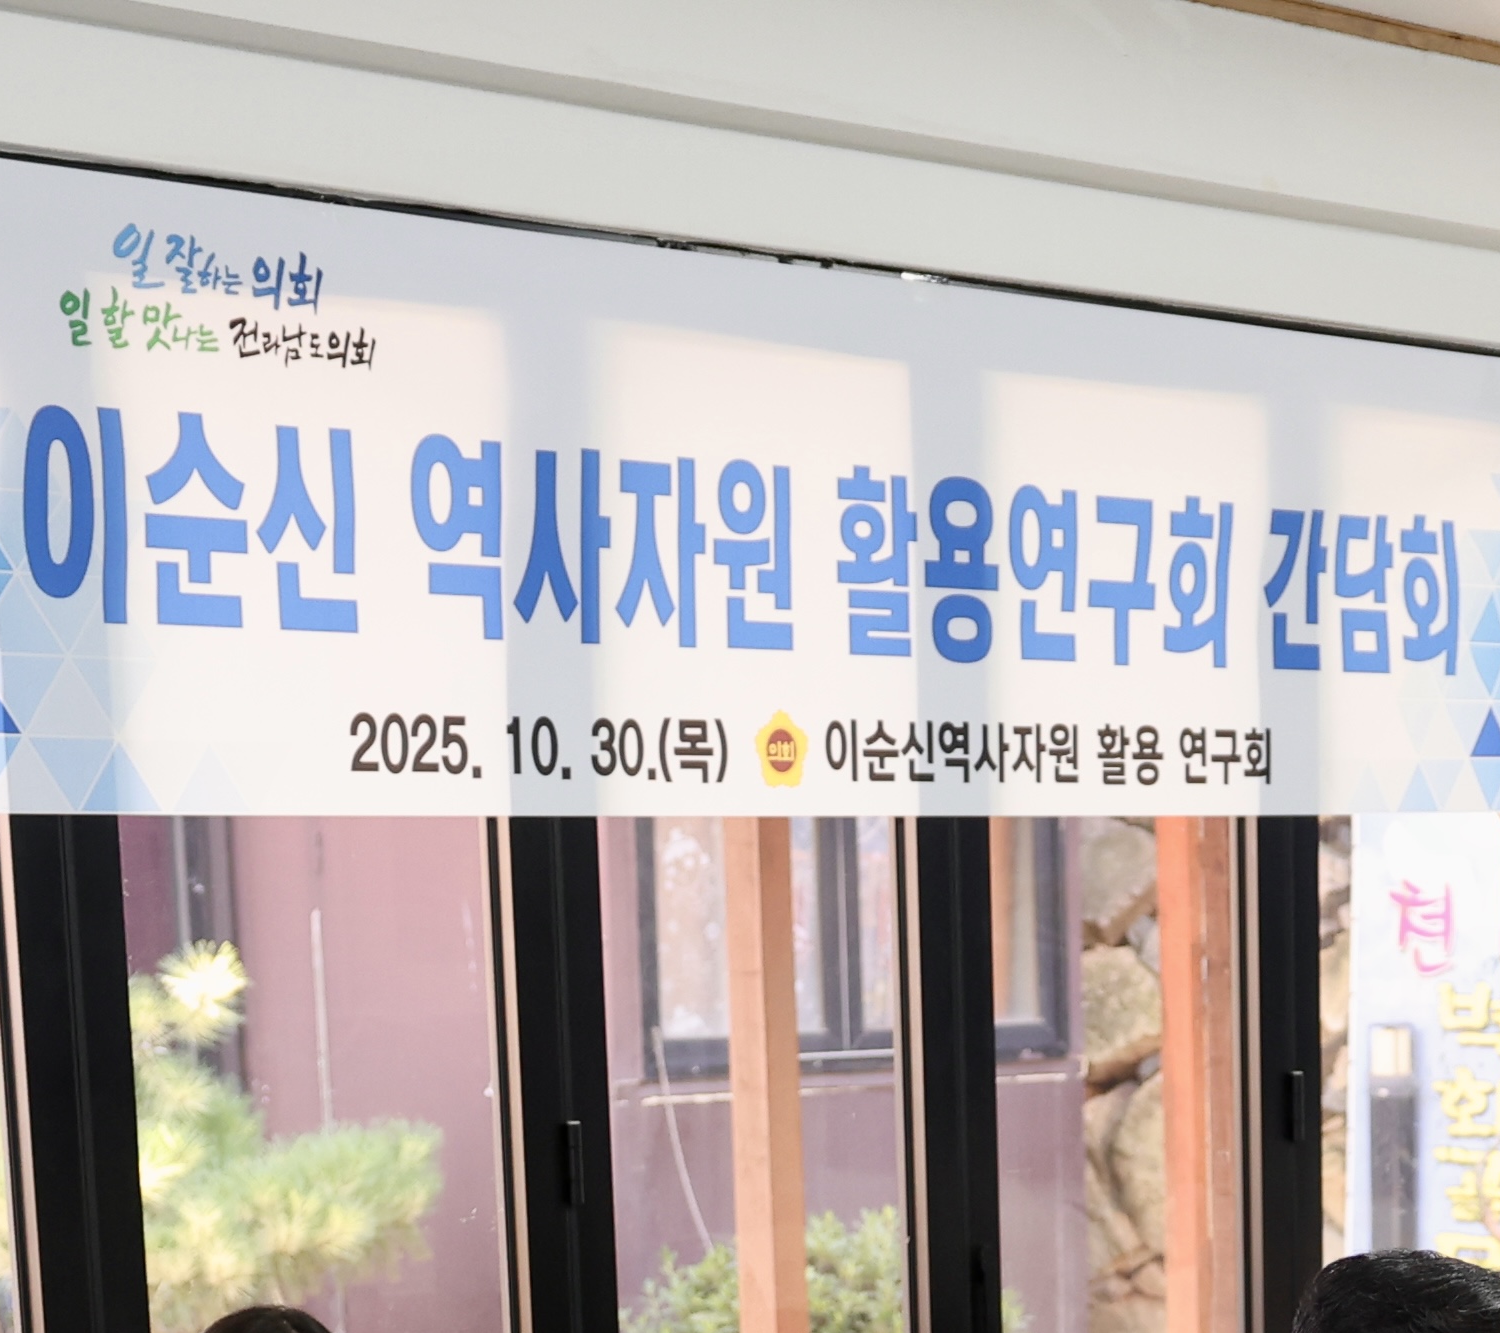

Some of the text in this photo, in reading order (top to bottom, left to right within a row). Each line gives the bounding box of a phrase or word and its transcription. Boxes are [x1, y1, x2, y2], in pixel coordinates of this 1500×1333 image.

[112, 222, 164, 289] 일
[252, 252, 324, 314] 의회
[229, 317, 377, 370] 전라남도의회
[23, 404, 1460, 676] 이순신 역사자원 활용연구회 간담회
[350, 713, 729, 784] 2025. 10. 30.(목)
[767, 740, 795, 761] 의회
[826, 719, 1273, 786] 이순신역사자원 활용 연구회
